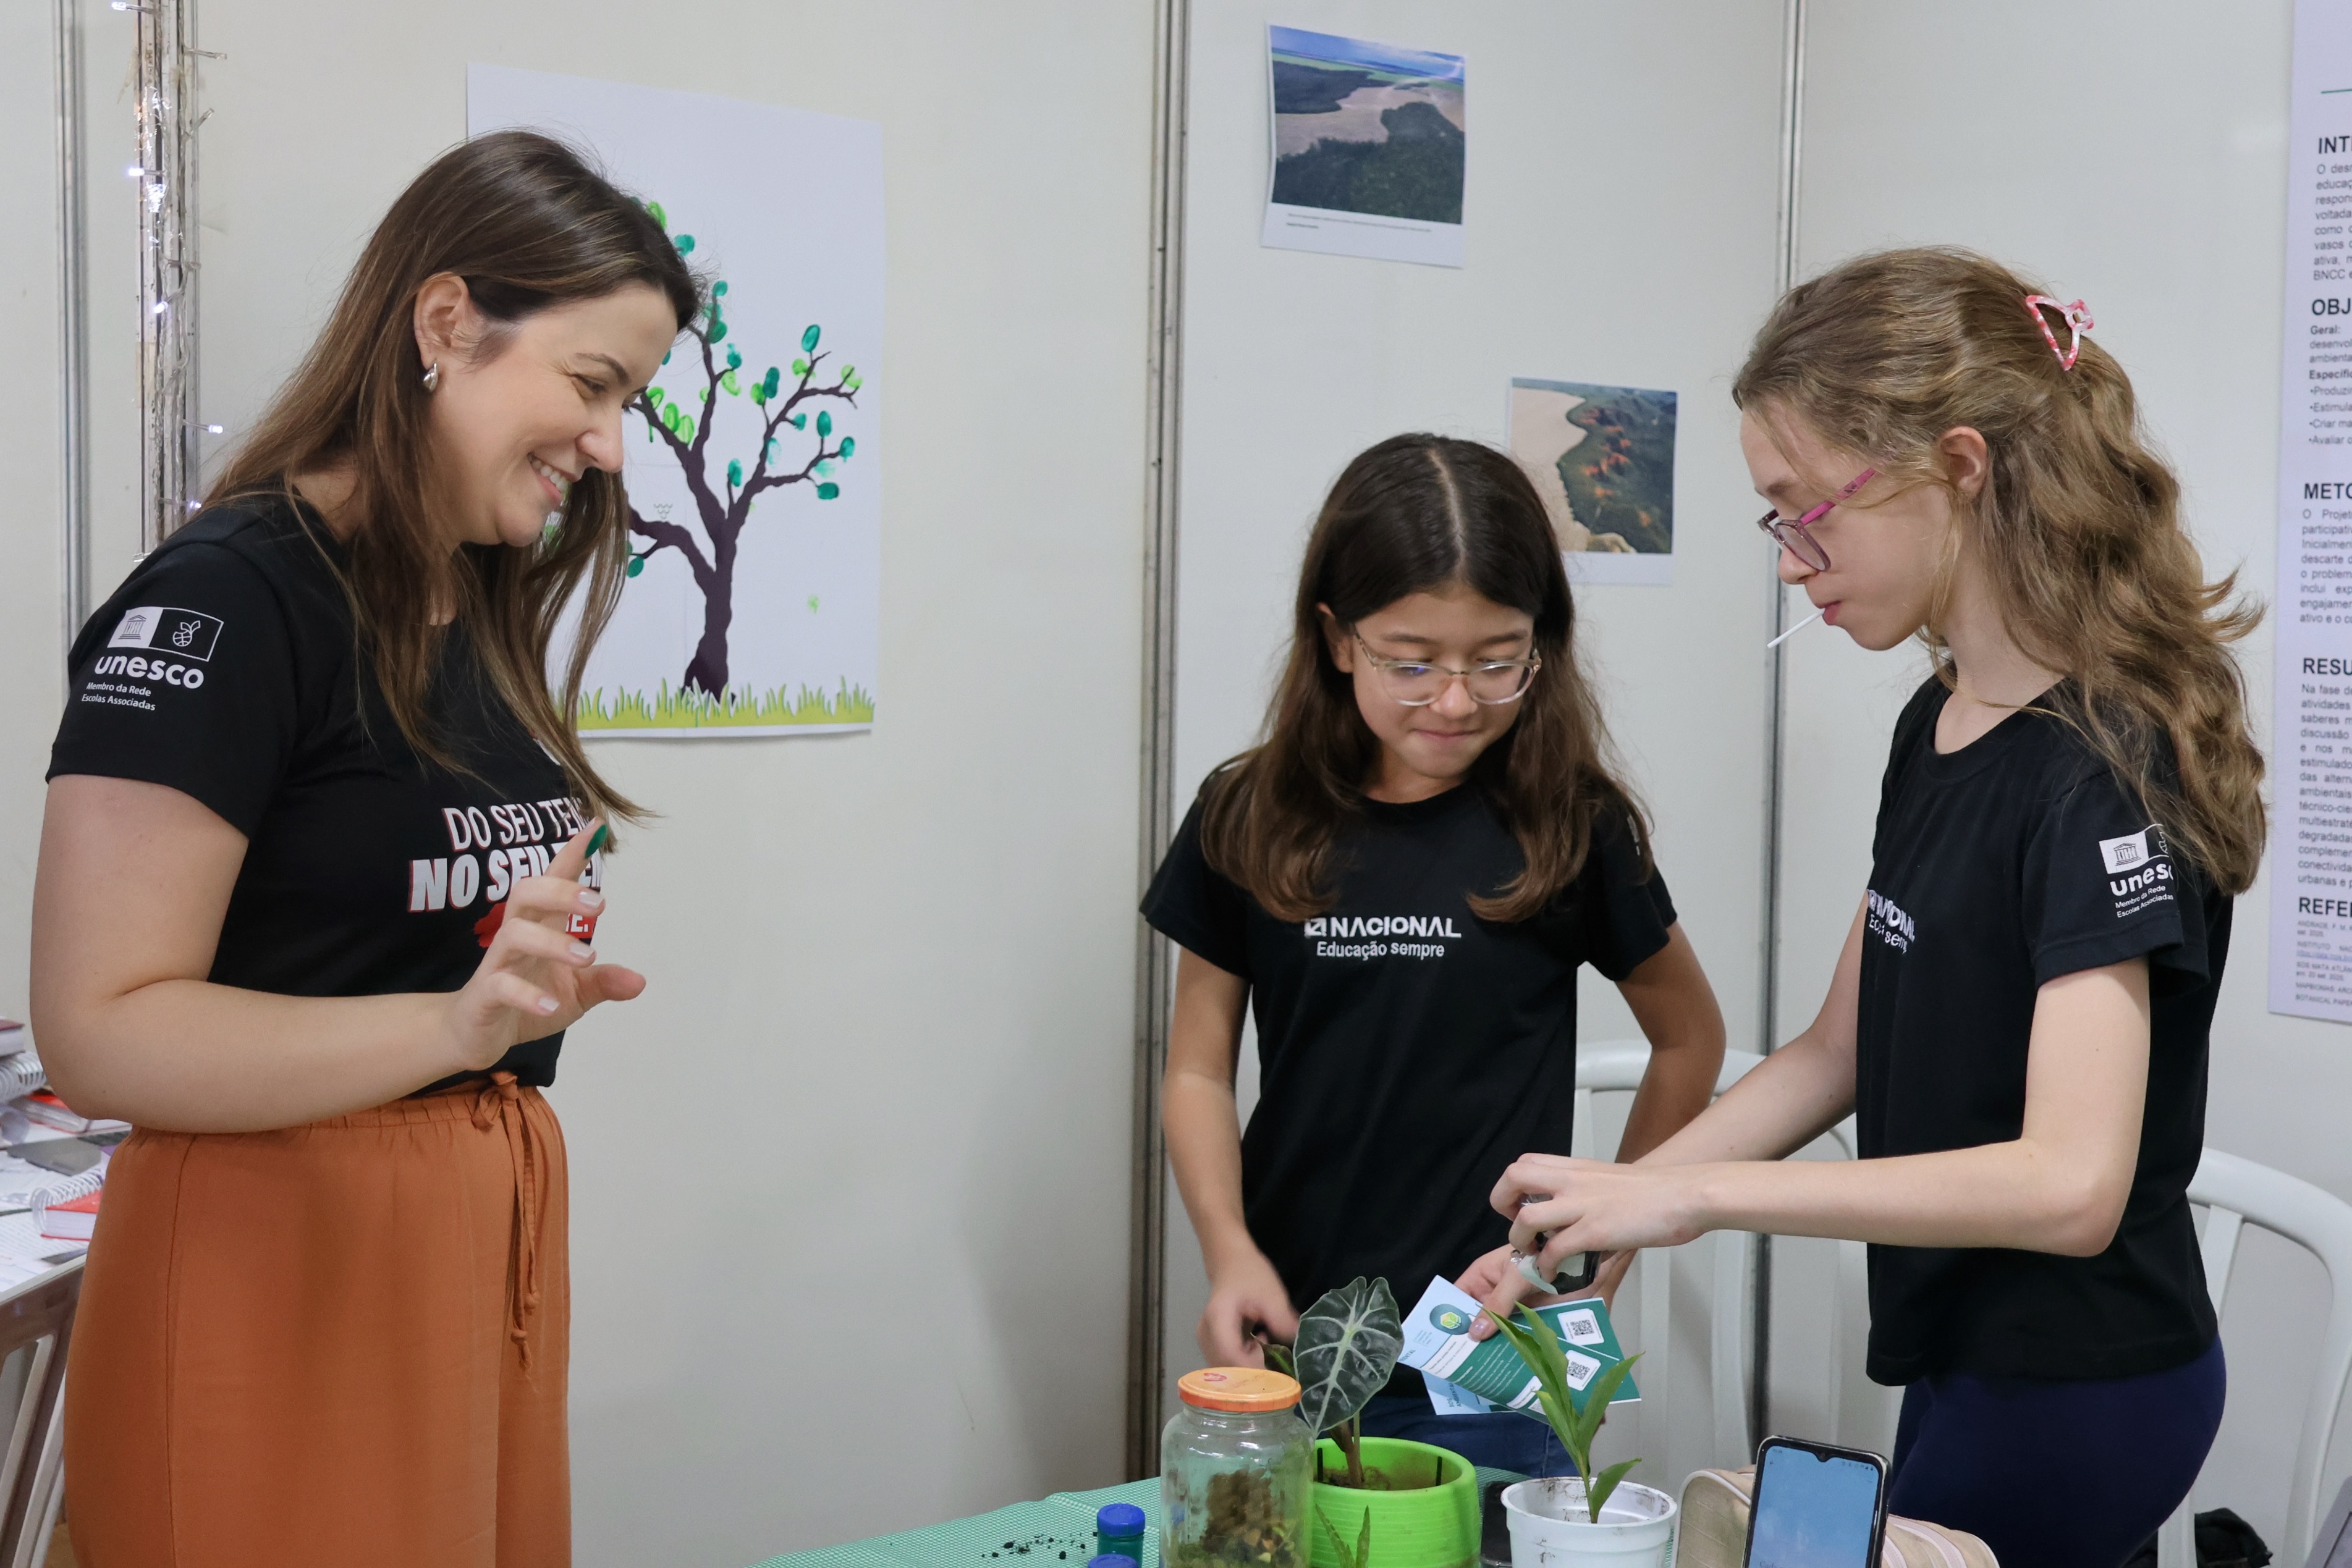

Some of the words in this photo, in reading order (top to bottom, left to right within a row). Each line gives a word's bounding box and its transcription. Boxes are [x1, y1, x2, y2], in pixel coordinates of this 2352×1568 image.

[2318, 135, 2352, 154] INT
[2317, 163, 2326, 175] O
[2312, 297, 2351, 316] OBJ
[95, 655, 204, 689] unesco
[86, 681, 114, 691] Membro
[116, 683, 128, 693] da
[129, 685, 151, 697] Rede
[81, 694, 106, 703] Escolas
[107, 695, 156, 710] Associadas
[441, 806, 492, 852] DO
[488, 803, 544, 846] SEU
[407, 854, 480, 913] NO
[2115, 896, 2140, 909] Membro
[2148, 885, 2166, 895] Rede
[2117, 905, 2140, 918] Escolas
[2141, 893, 2174, 909] Associadas
[2299, 896, 2352, 919] REFE
[1330, 916, 1462, 938] NACIONAL
[1316, 940, 1387, 961] Educação
[1390, 942, 1445, 961] sempre
